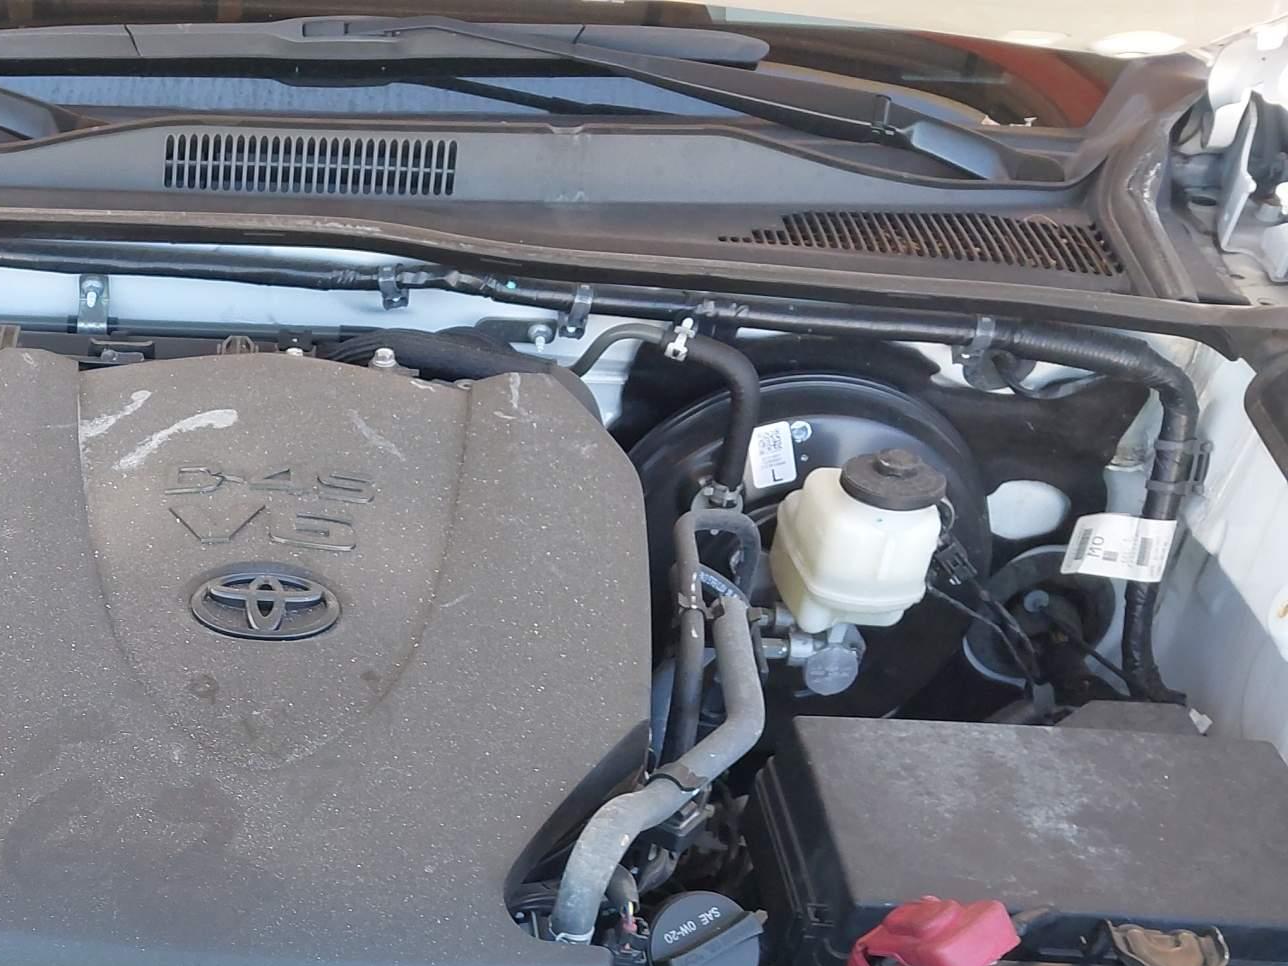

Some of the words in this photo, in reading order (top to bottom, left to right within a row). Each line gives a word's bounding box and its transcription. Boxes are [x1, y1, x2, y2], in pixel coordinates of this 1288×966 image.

[771, 469, 784, 482] L
[698, 906, 721, 926] SAE
[663, 920, 697, 945] 0W-20
